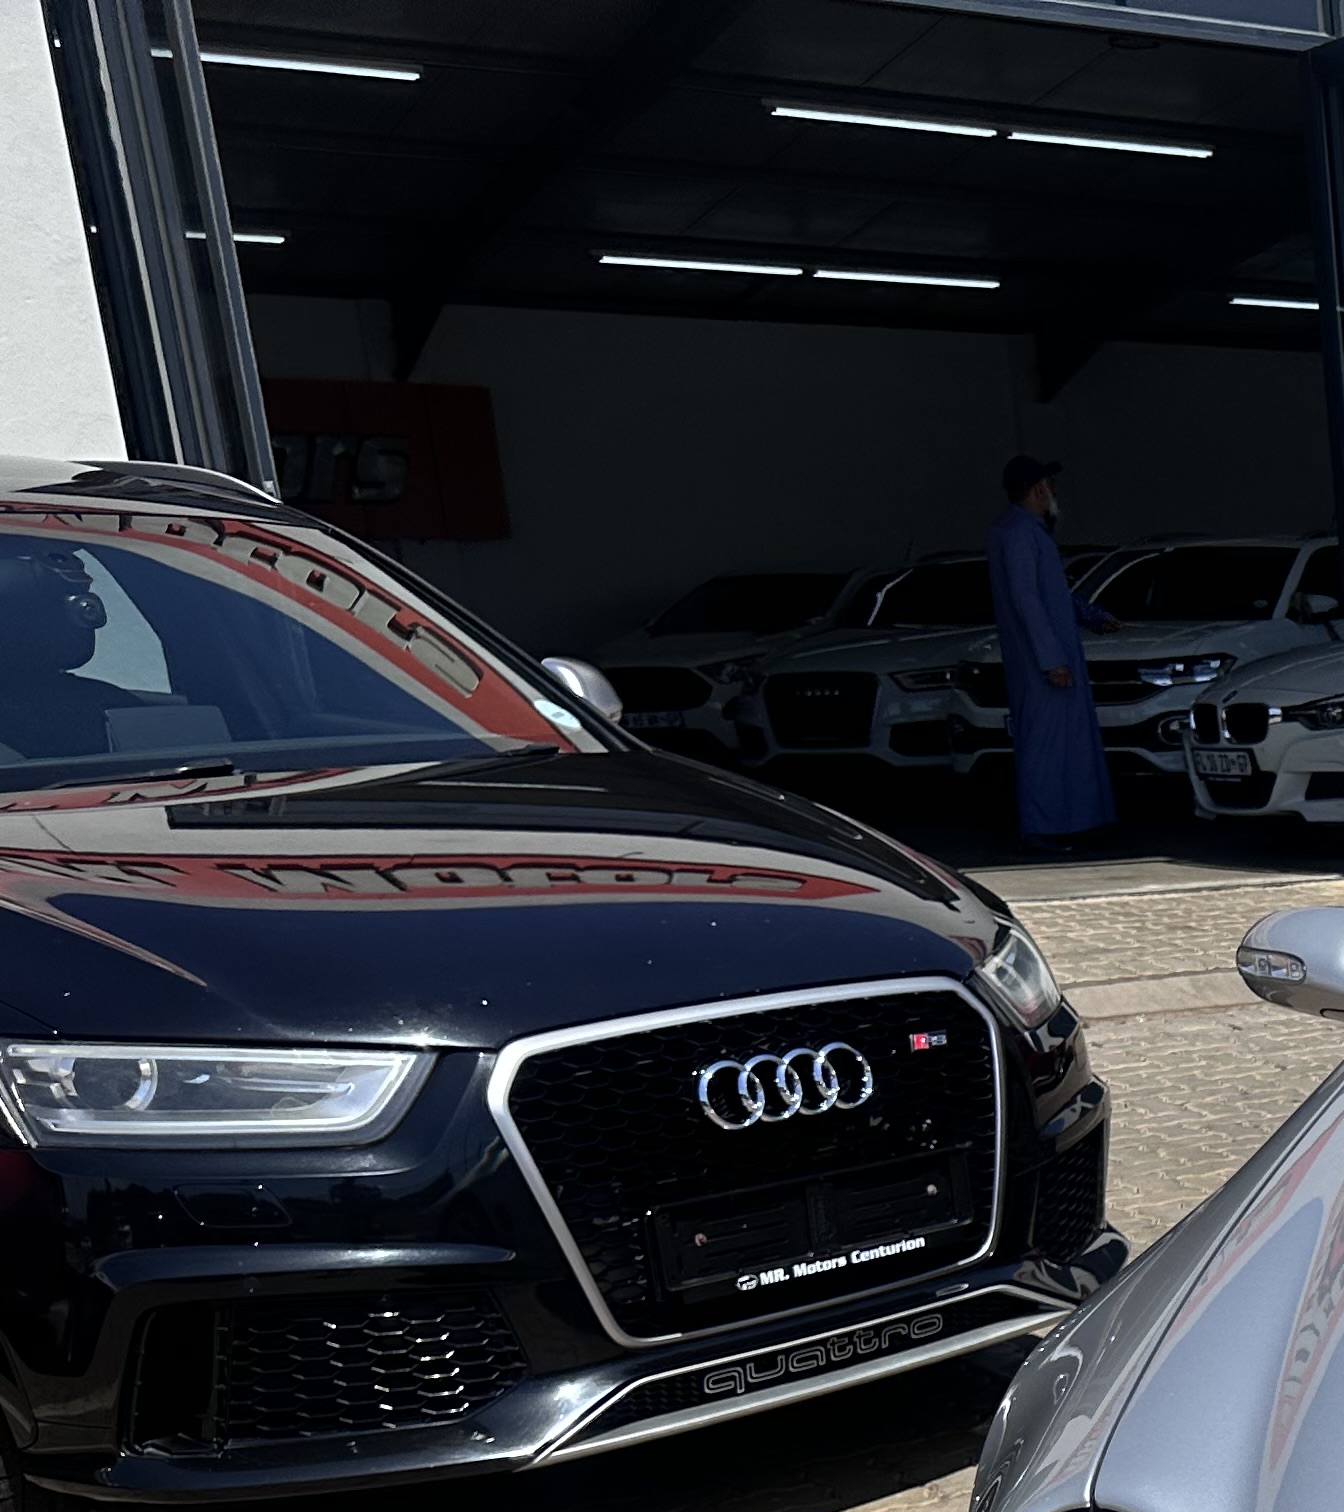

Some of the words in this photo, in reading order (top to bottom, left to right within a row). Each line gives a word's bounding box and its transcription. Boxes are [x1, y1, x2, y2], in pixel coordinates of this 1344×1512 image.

[760, 1268, 790, 1286] MR.
[793, 1255, 847, 1278] Motors
[851, 1237, 925, 1264] Centurion
[704, 1313, 943, 1393] quattro
